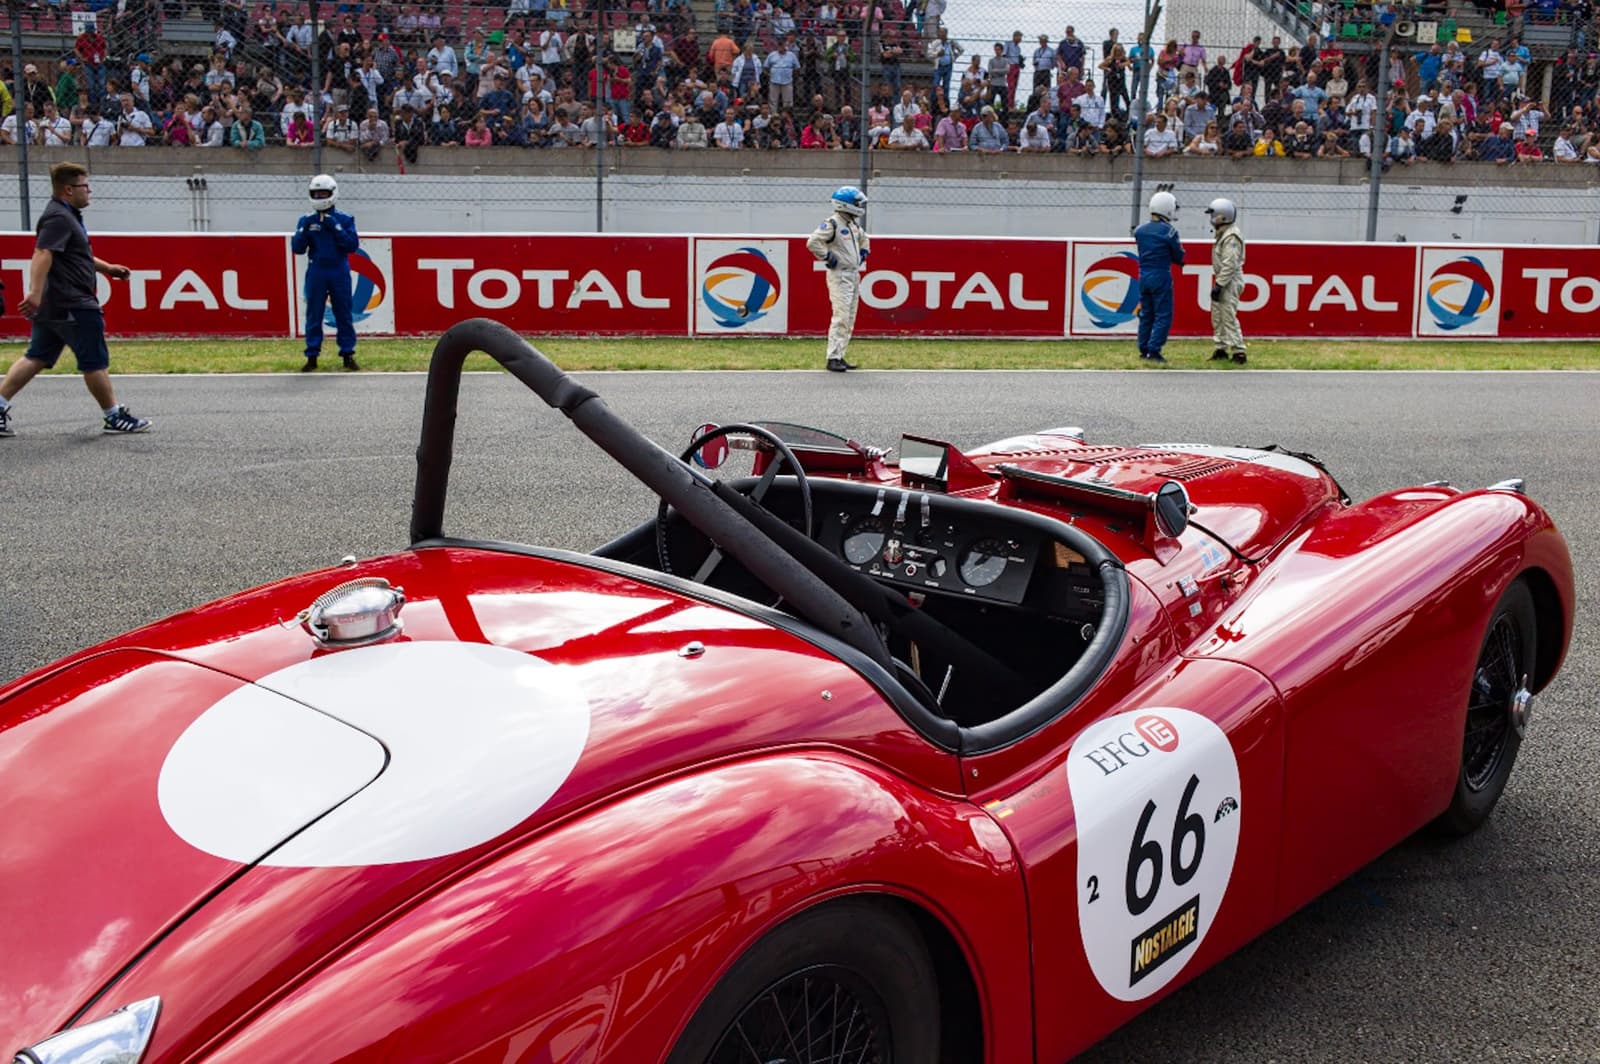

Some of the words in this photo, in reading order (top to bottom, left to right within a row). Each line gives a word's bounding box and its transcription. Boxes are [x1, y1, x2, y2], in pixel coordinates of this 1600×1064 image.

[417, 258, 671, 310] TOTAL
[1083, 732, 1150, 776] EFG
[1125, 773, 1206, 917] 66
[1086, 874, 1100, 905] 2
[1134, 906, 1197, 974] NOSTALGIE
